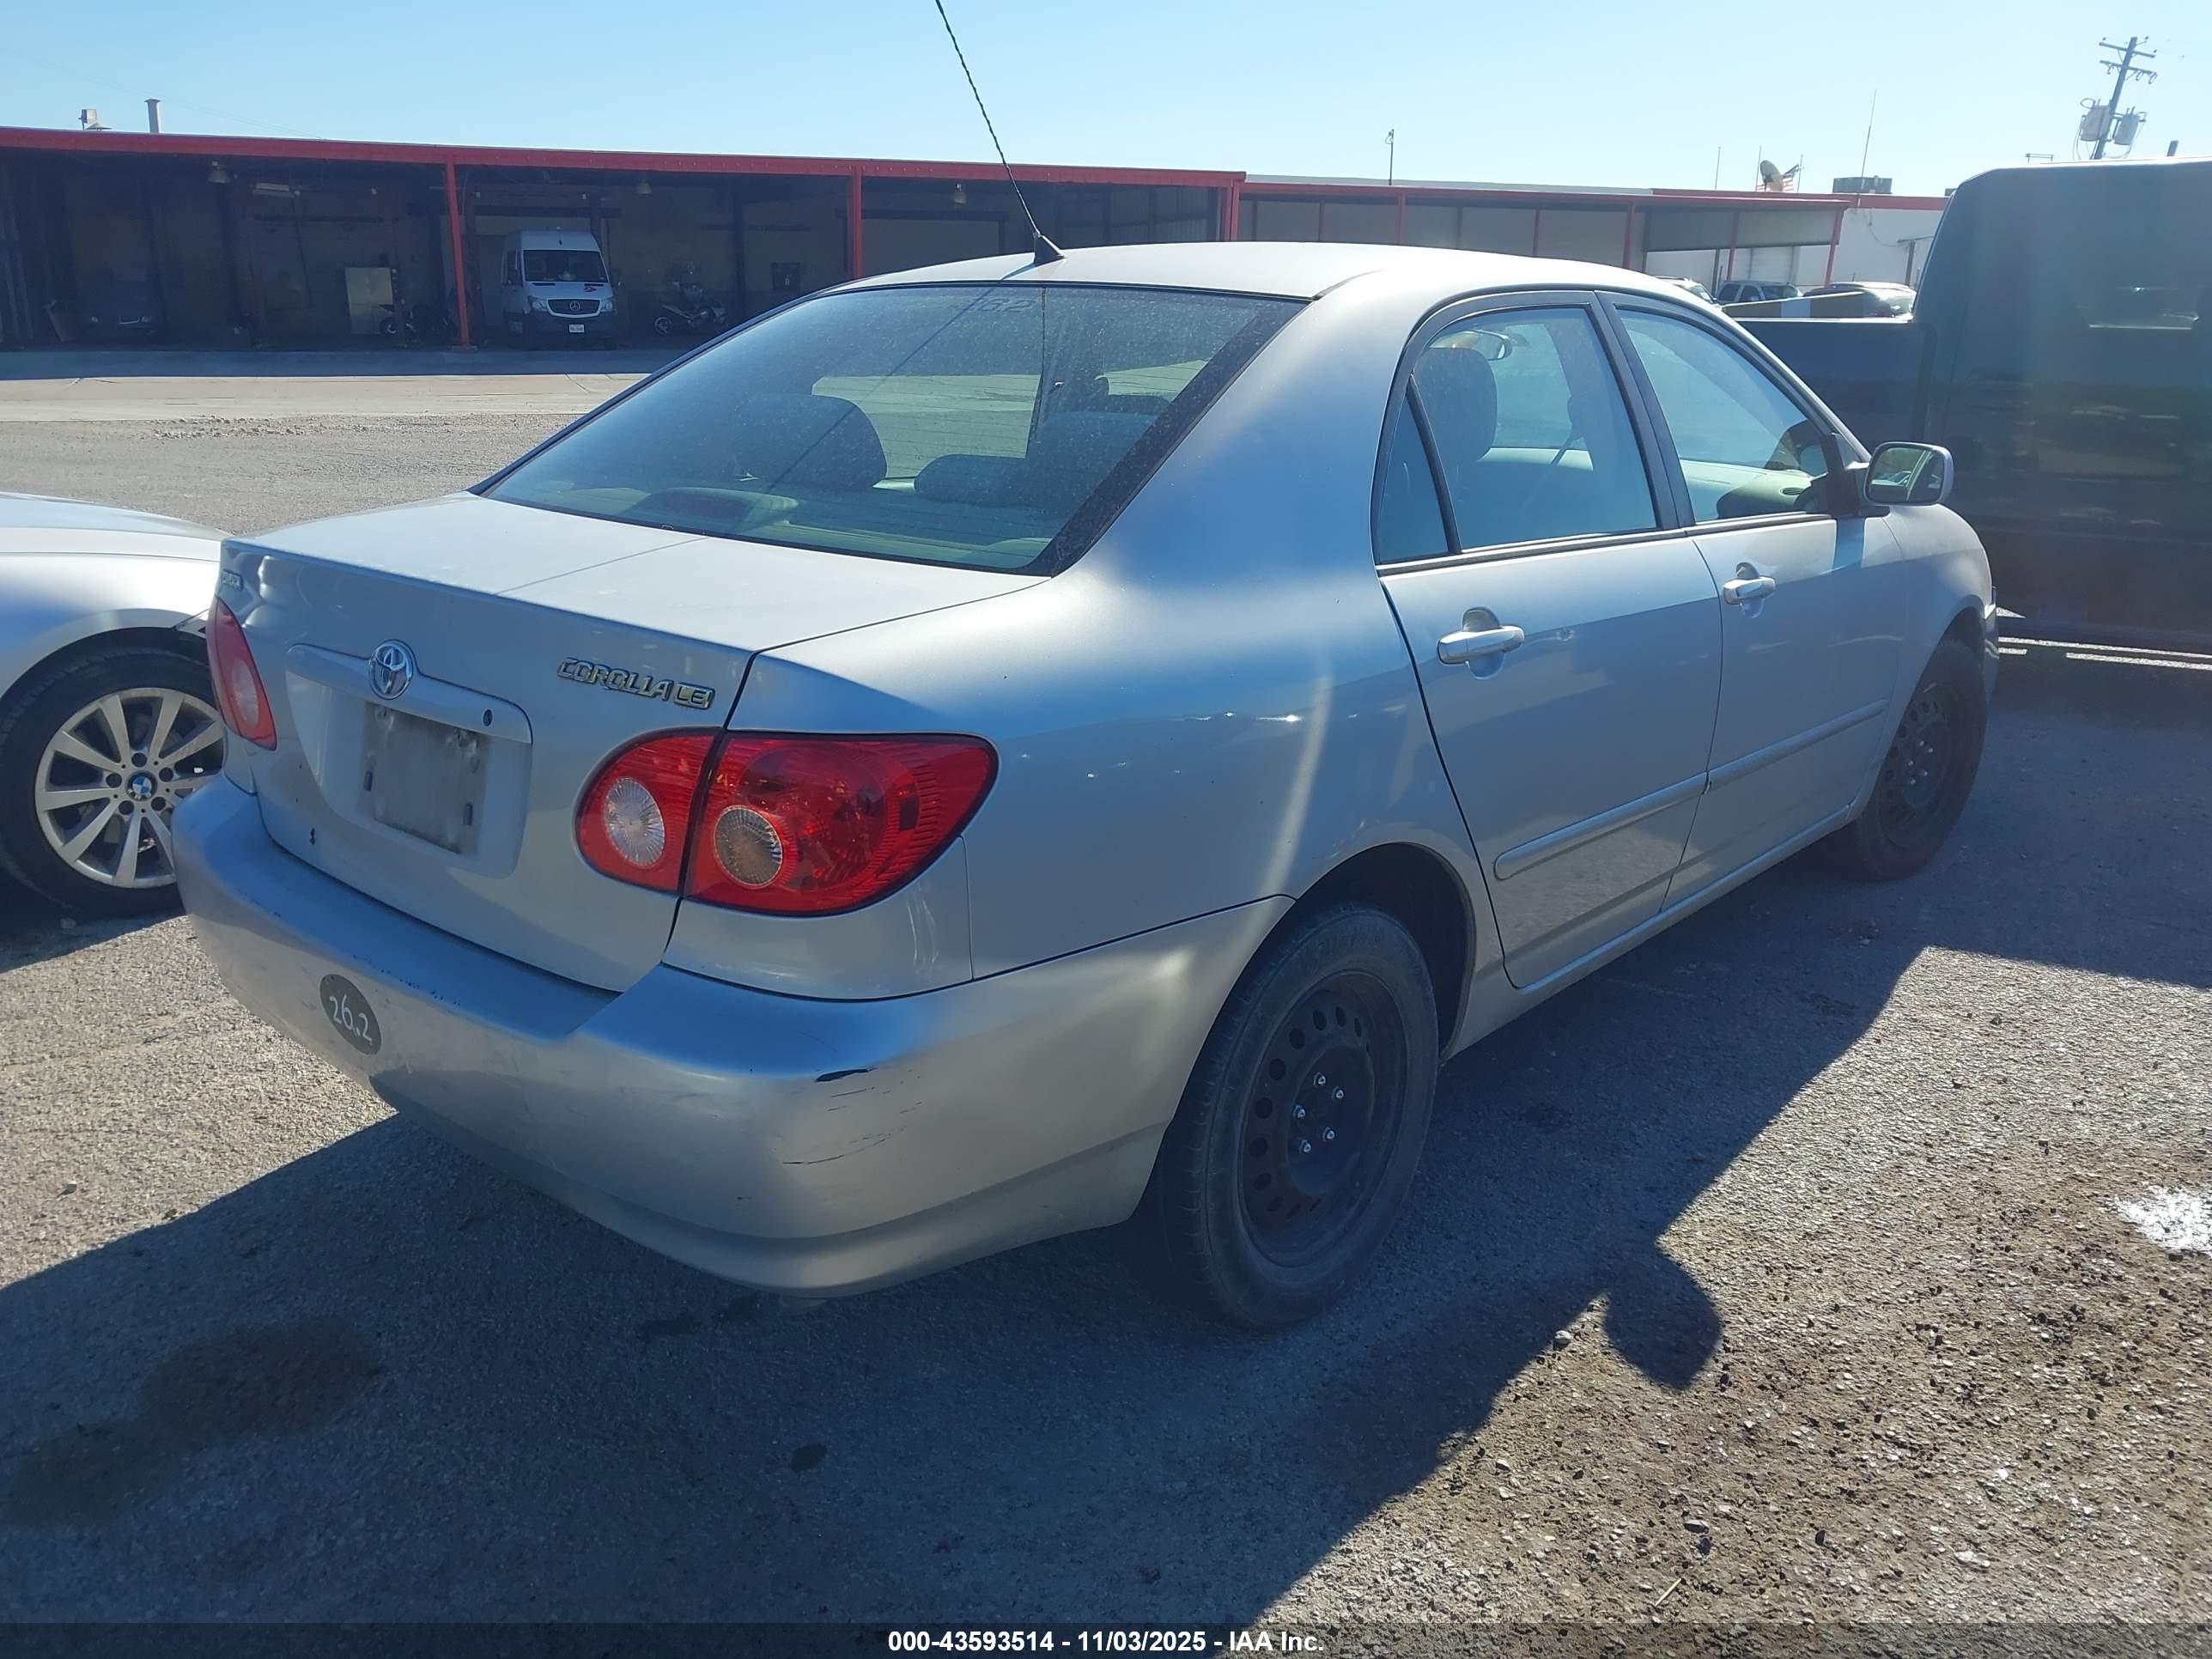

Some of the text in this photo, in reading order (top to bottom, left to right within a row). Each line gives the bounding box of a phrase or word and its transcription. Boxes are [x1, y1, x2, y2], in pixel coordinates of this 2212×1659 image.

[557, 658, 715, 710] COROLLA LE
[329, 994, 373, 1045] 26.2
